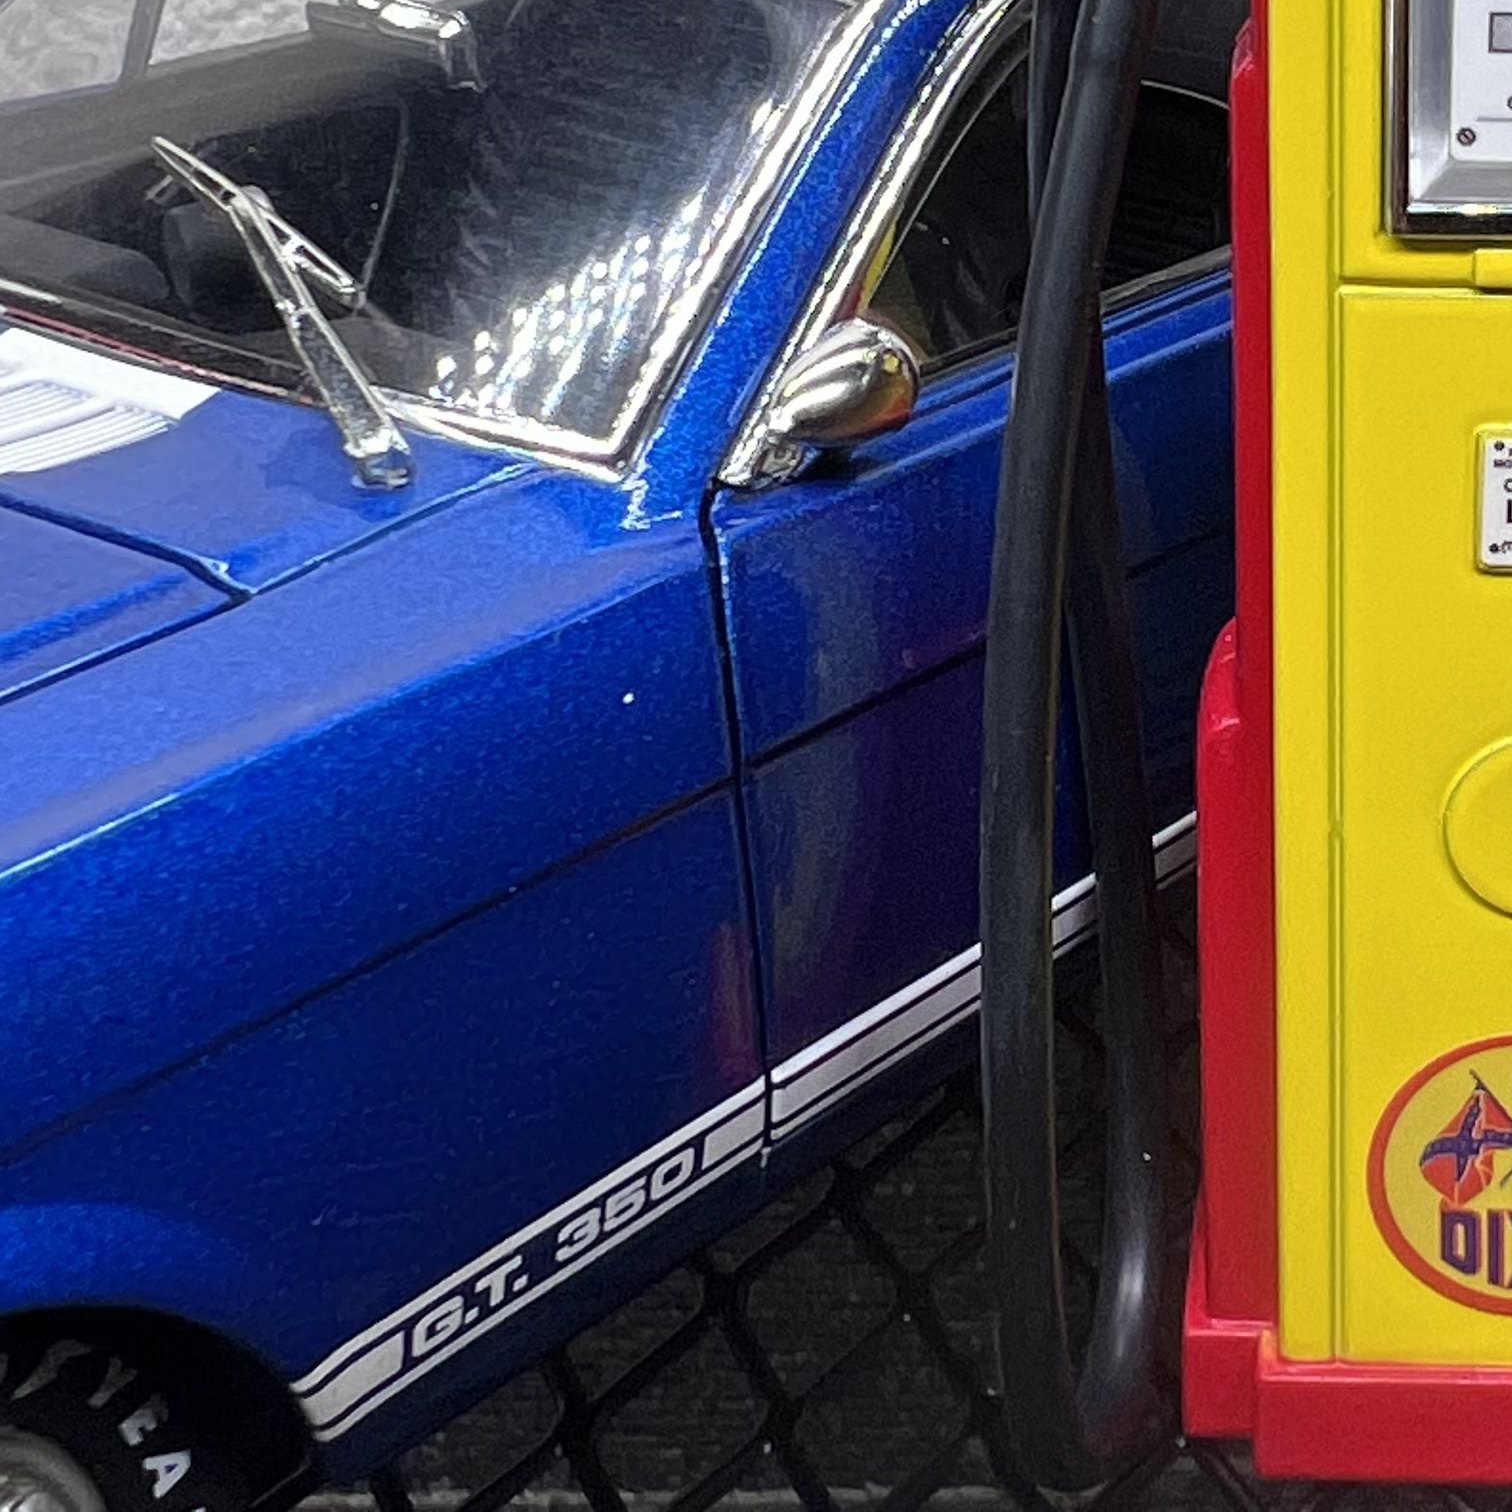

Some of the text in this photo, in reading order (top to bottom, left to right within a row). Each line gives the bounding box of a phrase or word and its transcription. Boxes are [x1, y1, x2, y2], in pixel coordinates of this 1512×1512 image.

[411, 1146, 695, 1358] G.T. 350
[86, 1353, 208, 1512] YEA
